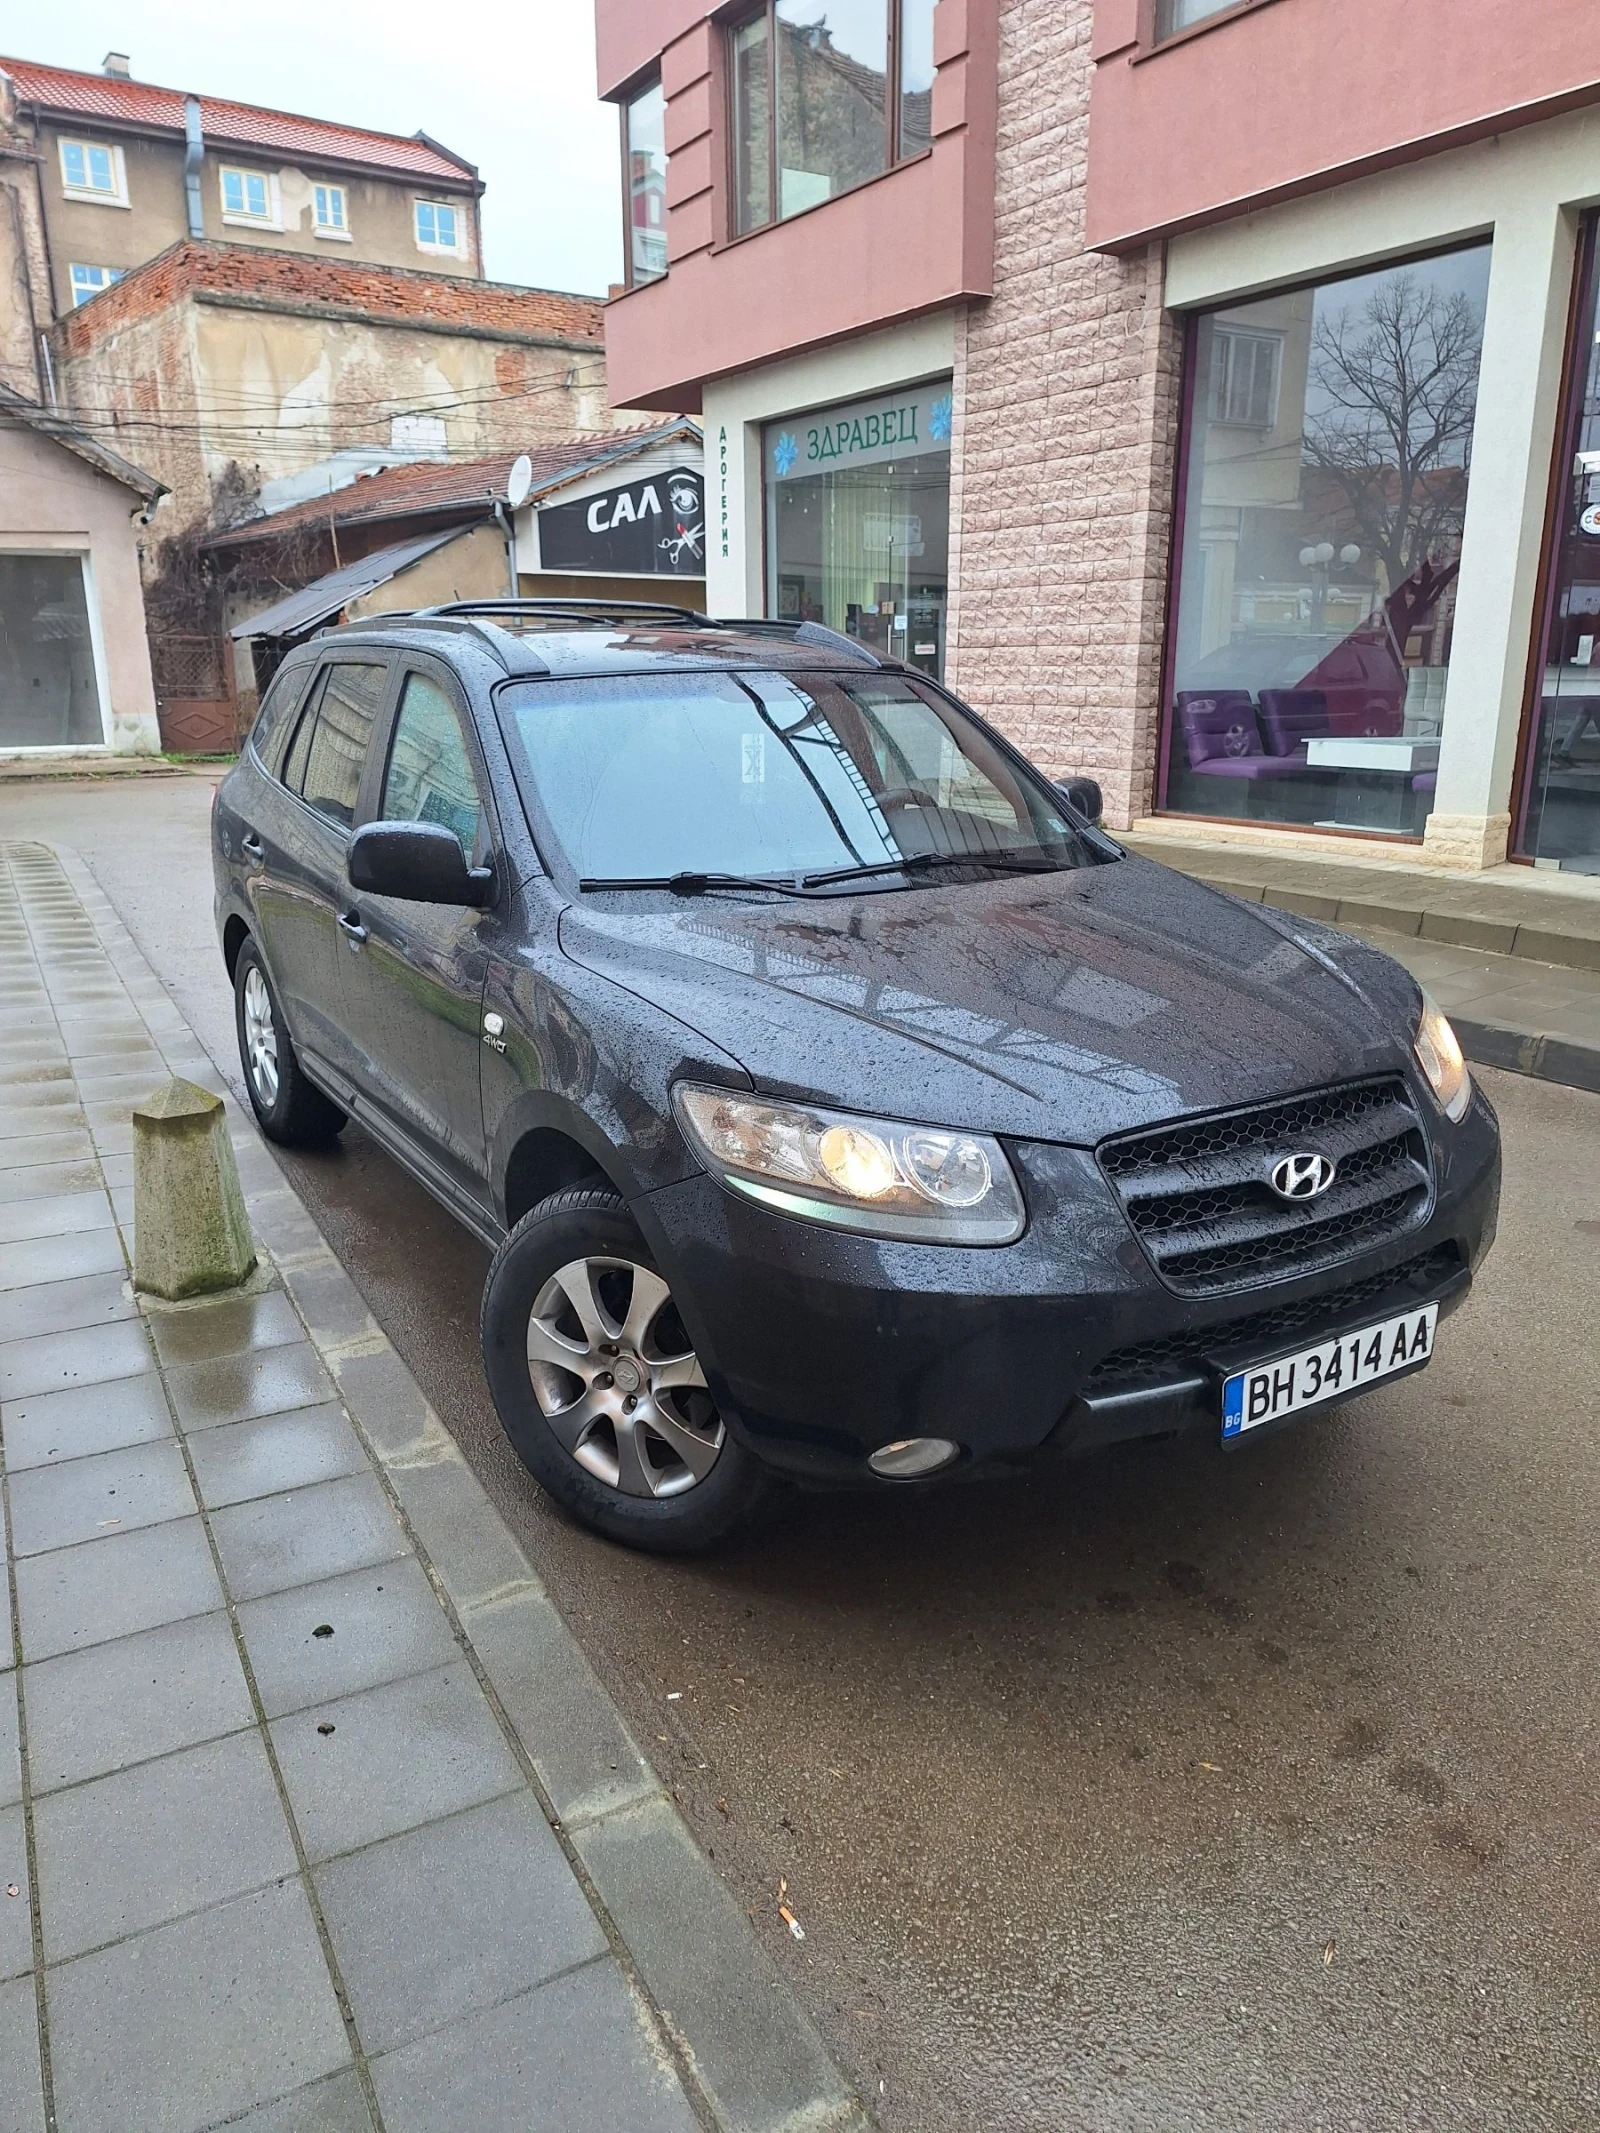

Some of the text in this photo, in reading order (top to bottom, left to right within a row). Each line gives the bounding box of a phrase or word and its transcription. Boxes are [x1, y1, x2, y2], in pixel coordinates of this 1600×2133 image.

[807, 405, 918, 462] ЗДРАВЕЦ
[482, 1033, 507, 1054] 4WD
[1248, 1315, 1428, 1422] BH 3414 AA
[1225, 1412, 1241, 1429] BG
